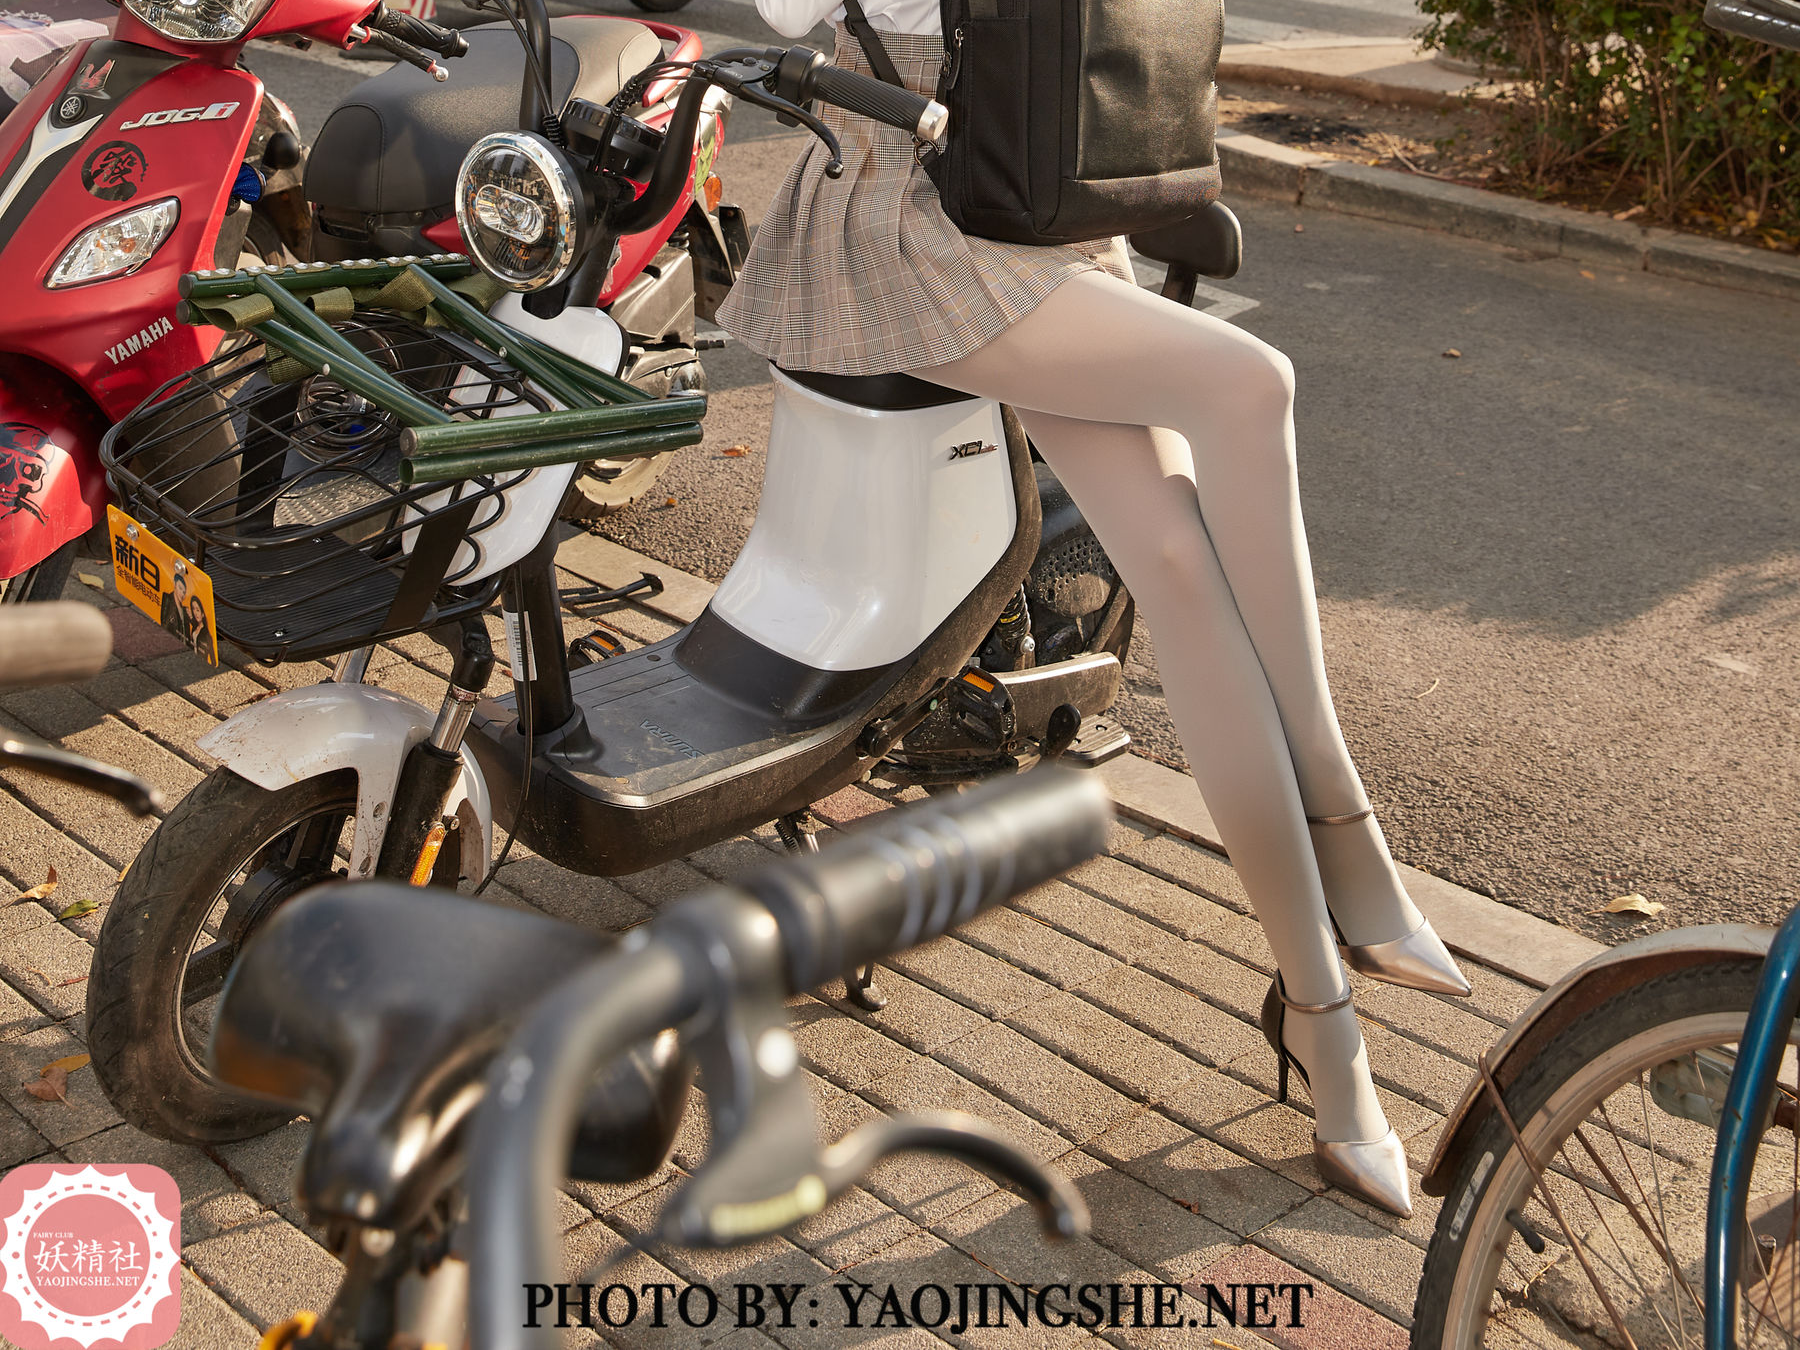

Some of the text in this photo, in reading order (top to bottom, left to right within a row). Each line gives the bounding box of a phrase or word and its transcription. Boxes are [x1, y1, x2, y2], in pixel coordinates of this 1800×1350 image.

[104, 316, 174, 366] YAMAHA
[114, 534, 161, 593] 新日
[116, 564, 161, 607] 全智能电动车
